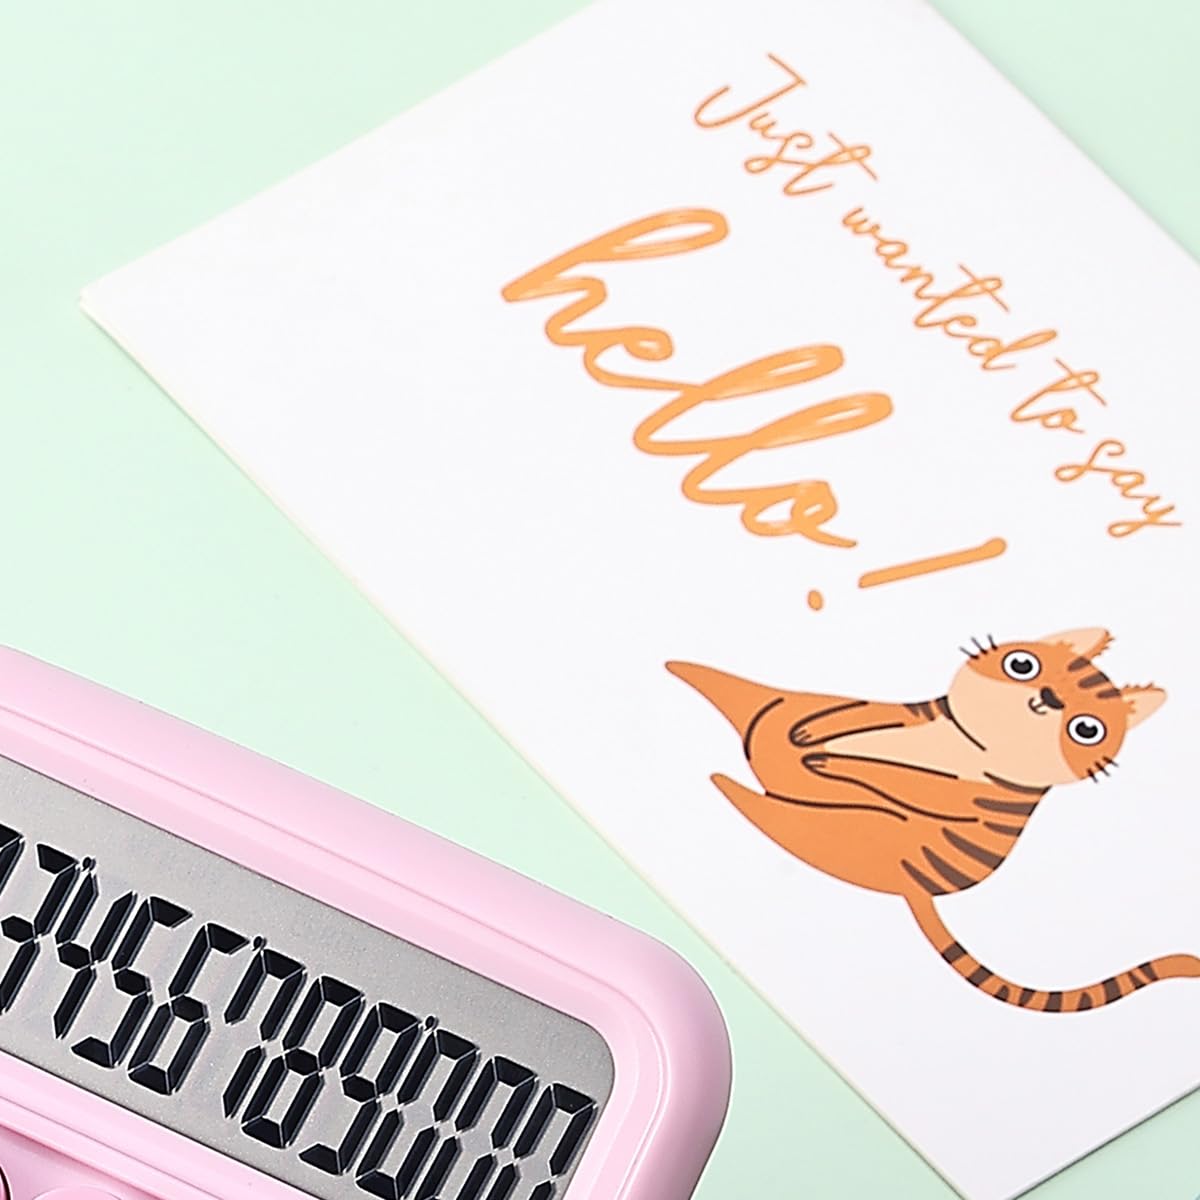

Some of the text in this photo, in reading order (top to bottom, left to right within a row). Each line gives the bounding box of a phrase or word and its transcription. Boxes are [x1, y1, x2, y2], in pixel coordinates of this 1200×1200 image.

[693, 52, 1182, 539] Just wanted to say
